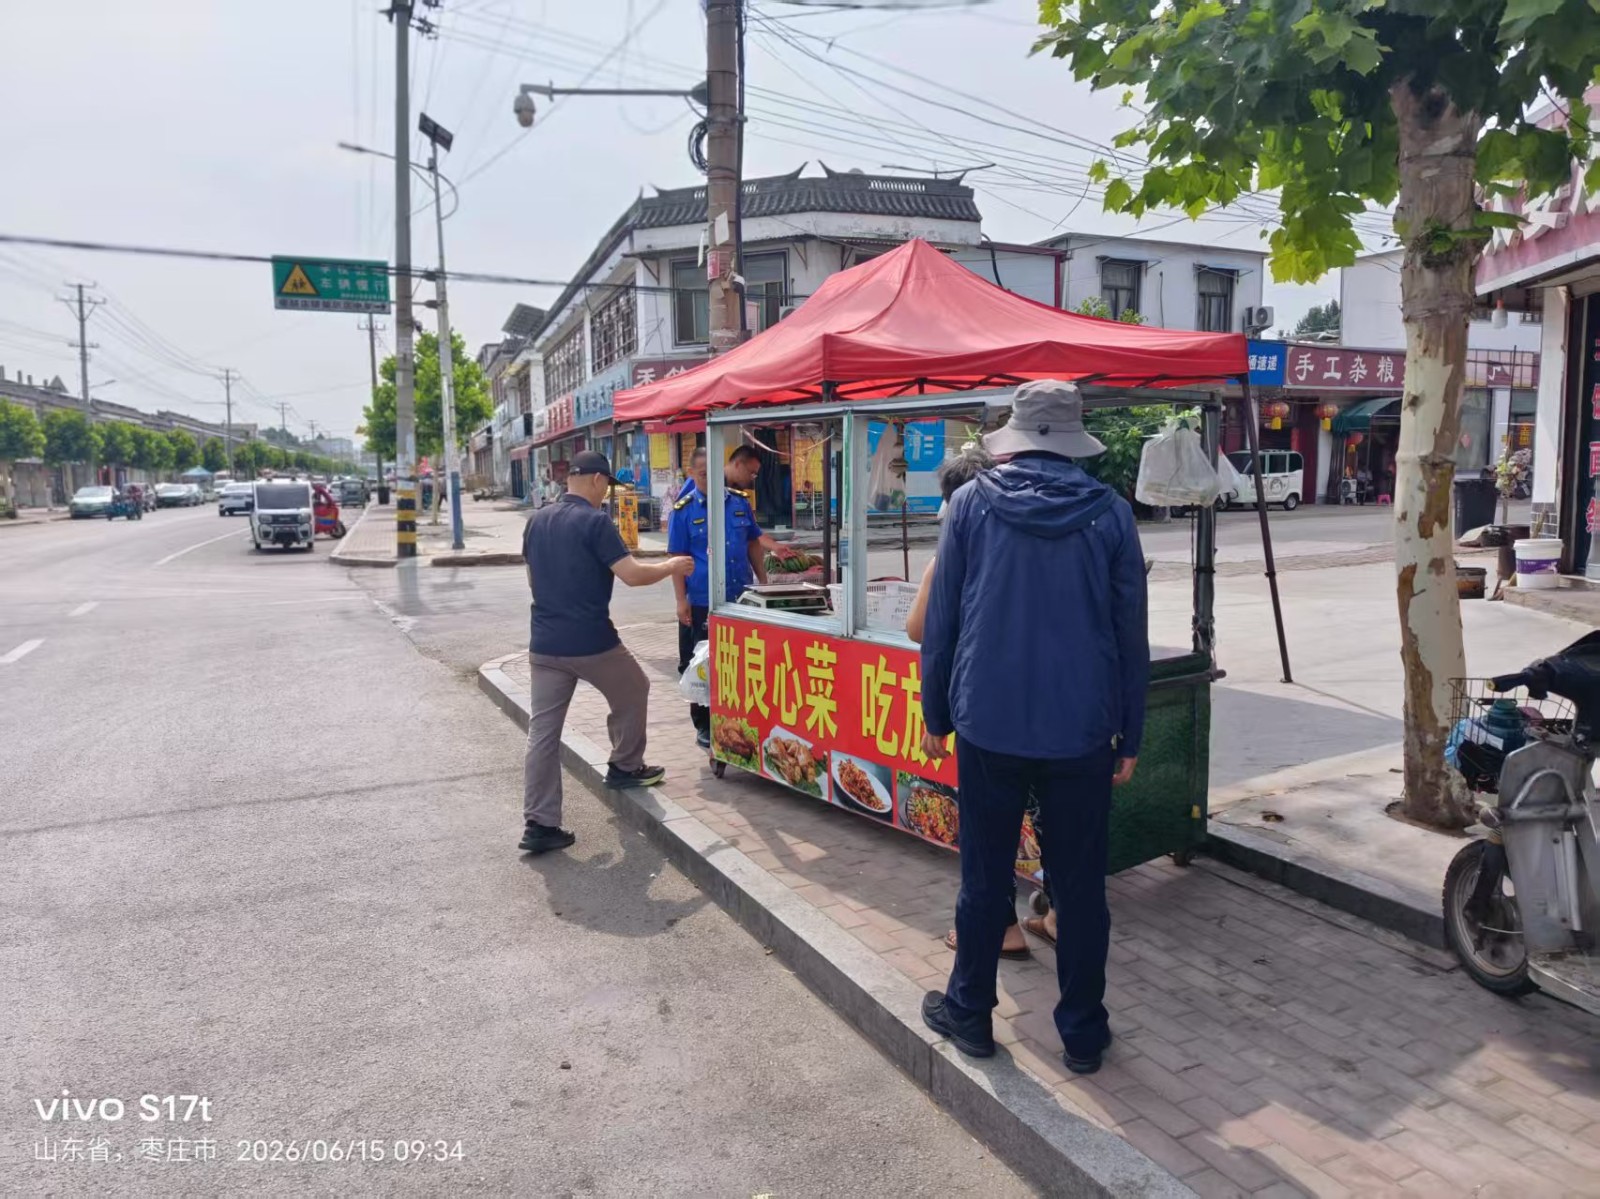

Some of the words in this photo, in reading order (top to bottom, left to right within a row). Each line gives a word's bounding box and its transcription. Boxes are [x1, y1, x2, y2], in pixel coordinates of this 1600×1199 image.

[1295, 353, 1406, 385] 手工杂粮
[715, 623, 838, 739] 做良心菜
[861, 654, 956, 772] 吃放
